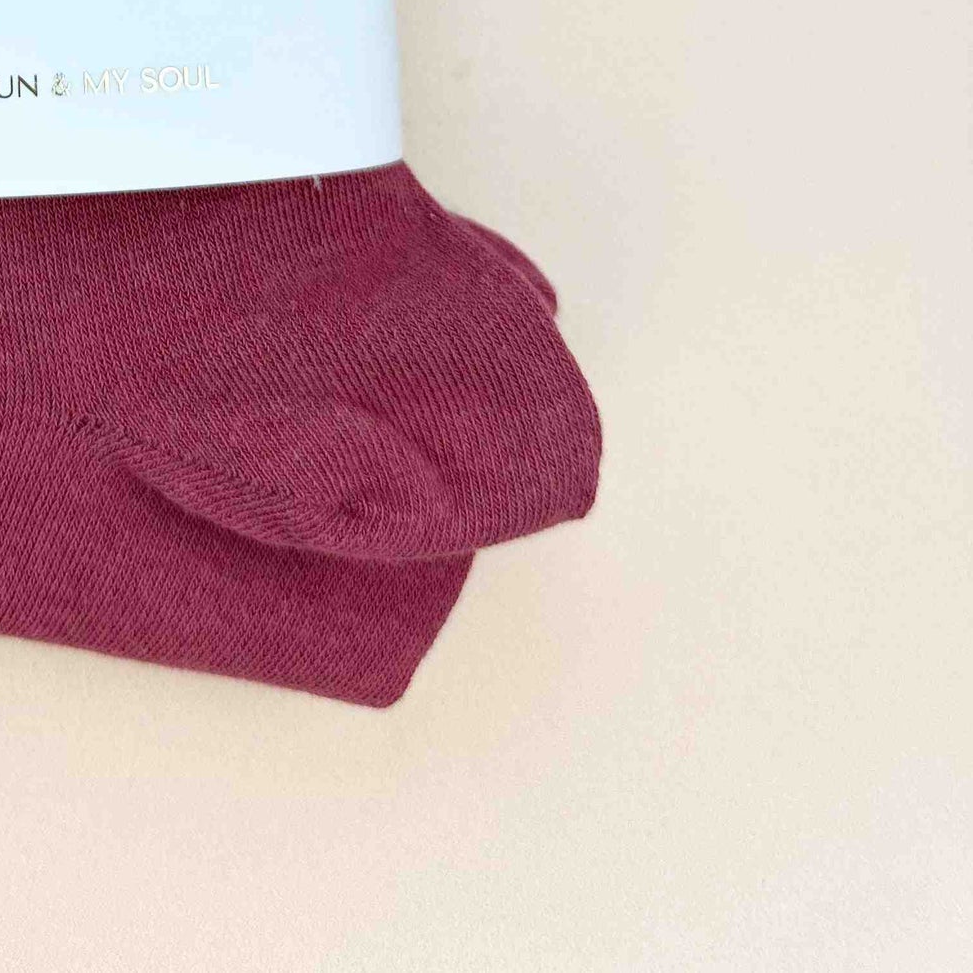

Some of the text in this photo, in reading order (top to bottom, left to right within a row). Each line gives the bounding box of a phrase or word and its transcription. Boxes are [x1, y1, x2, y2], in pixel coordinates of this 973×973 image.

[50, 72, 73, 97] &
[82, 69, 130, 95] MY
[139, 65, 220, 93] SOUL
